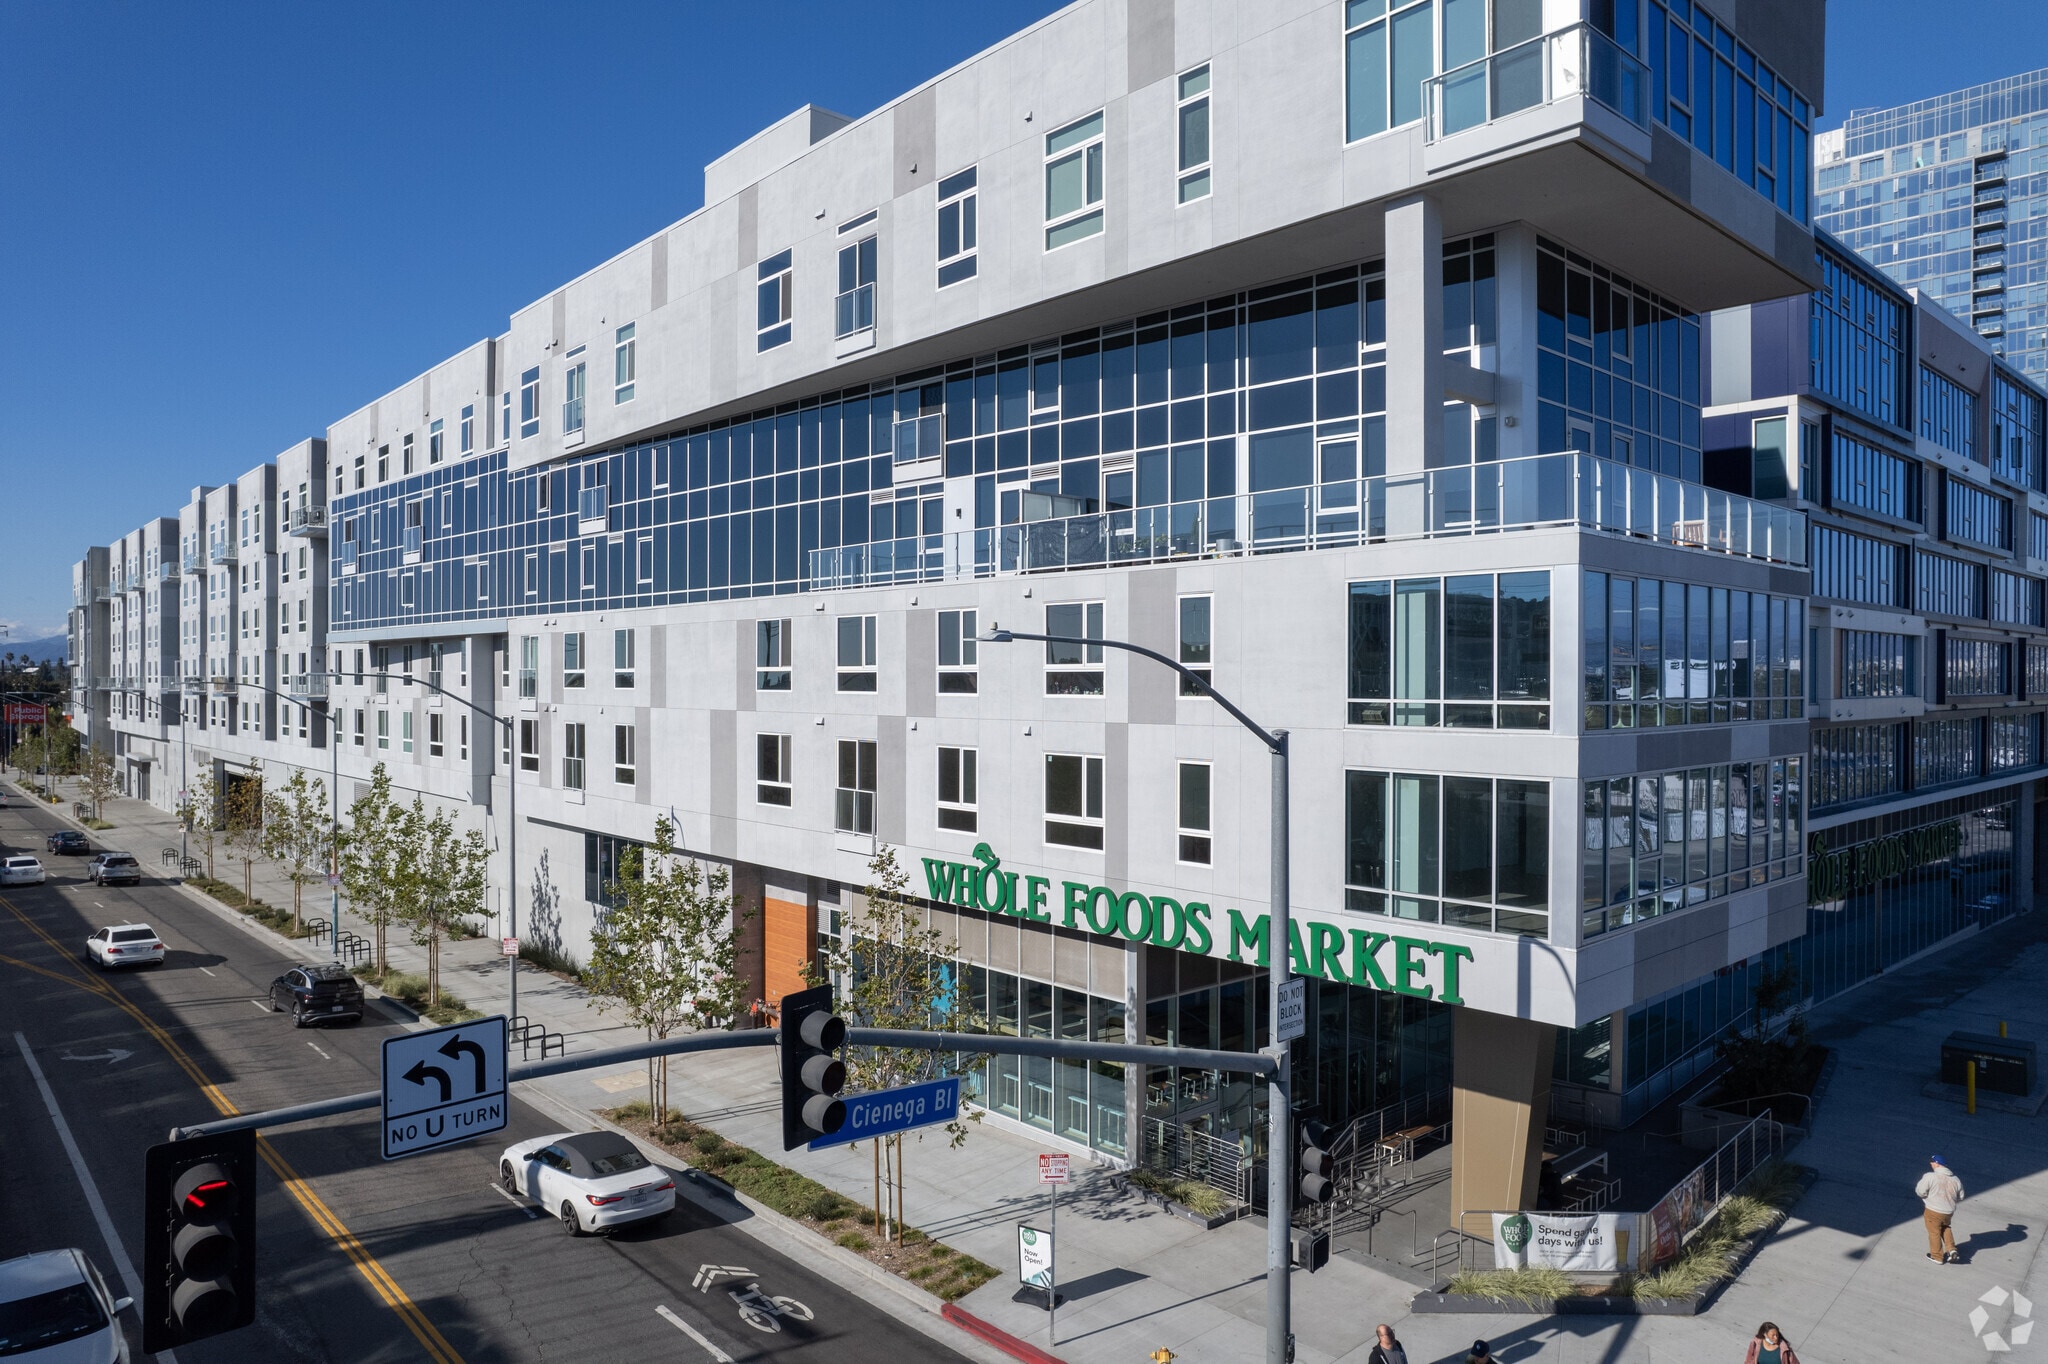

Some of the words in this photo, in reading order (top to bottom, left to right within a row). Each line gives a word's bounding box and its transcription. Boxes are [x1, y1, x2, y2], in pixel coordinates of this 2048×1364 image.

[10, 713, 46, 721] Storage
[1807, 832, 1850, 904] HOLE
[1855, 833, 1907, 888] FOODS
[1911, 820, 1962, 868] MARKET
[921, 842, 1051, 924] WHOLE
[1062, 880, 1212, 955] FOODS
[1227, 909, 1474, 1006] MARKET
[1279, 991, 1288, 1003] DO
[1291, 986, 1303, 999] NOT
[1281, 1004, 1302, 1019] BLOCK
[852, 1097, 925, 1129] Cienega
[935, 1087, 952, 1112] Bl
[392, 1124, 418, 1144] NO
[426, 1115, 444, 1138] U
[453, 1104, 500, 1129] TURN
[1040, 1158, 1049, 1167] NO
[1503, 1223, 1530, 1234] WHOE
[1538, 1224, 1572, 1237] Spend
[1573, 1226, 1599, 1240] game
[1505, 1233, 1528, 1242] FOOS
[1538, 1236, 1562, 1247] days
[1564, 1238, 1586, 1248] with
[1588, 1236, 1603, 1246] us!
[1024, 1248, 1038, 1257] Now
[1024, 1255, 1043, 1265] Open!
